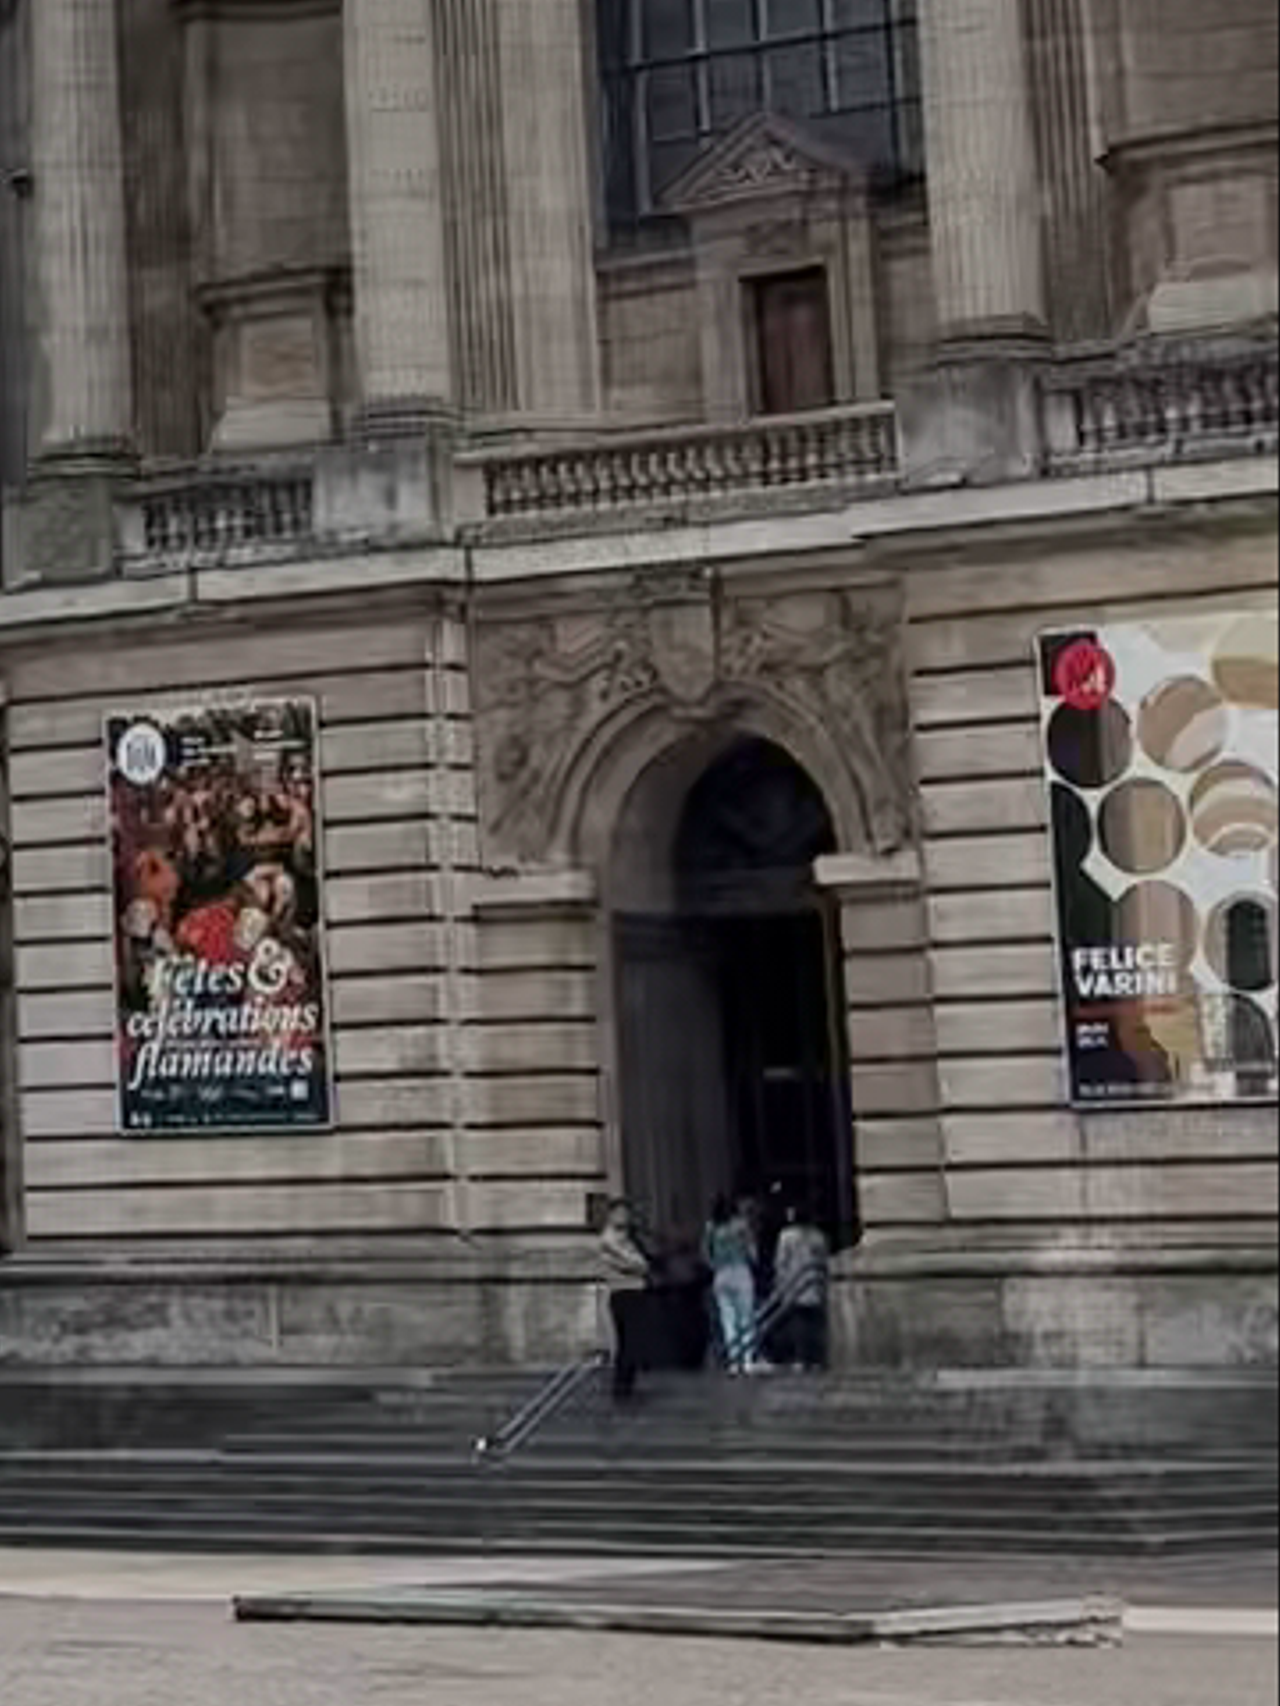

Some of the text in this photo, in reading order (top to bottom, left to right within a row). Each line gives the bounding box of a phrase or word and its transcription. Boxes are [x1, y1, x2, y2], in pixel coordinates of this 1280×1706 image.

[247, 938, 293, 995] &
[1074, 943, 1175, 971] FELICE
[1075, 971, 1177, 997] VARINI
[127, 1039, 314, 1090] flamandes
